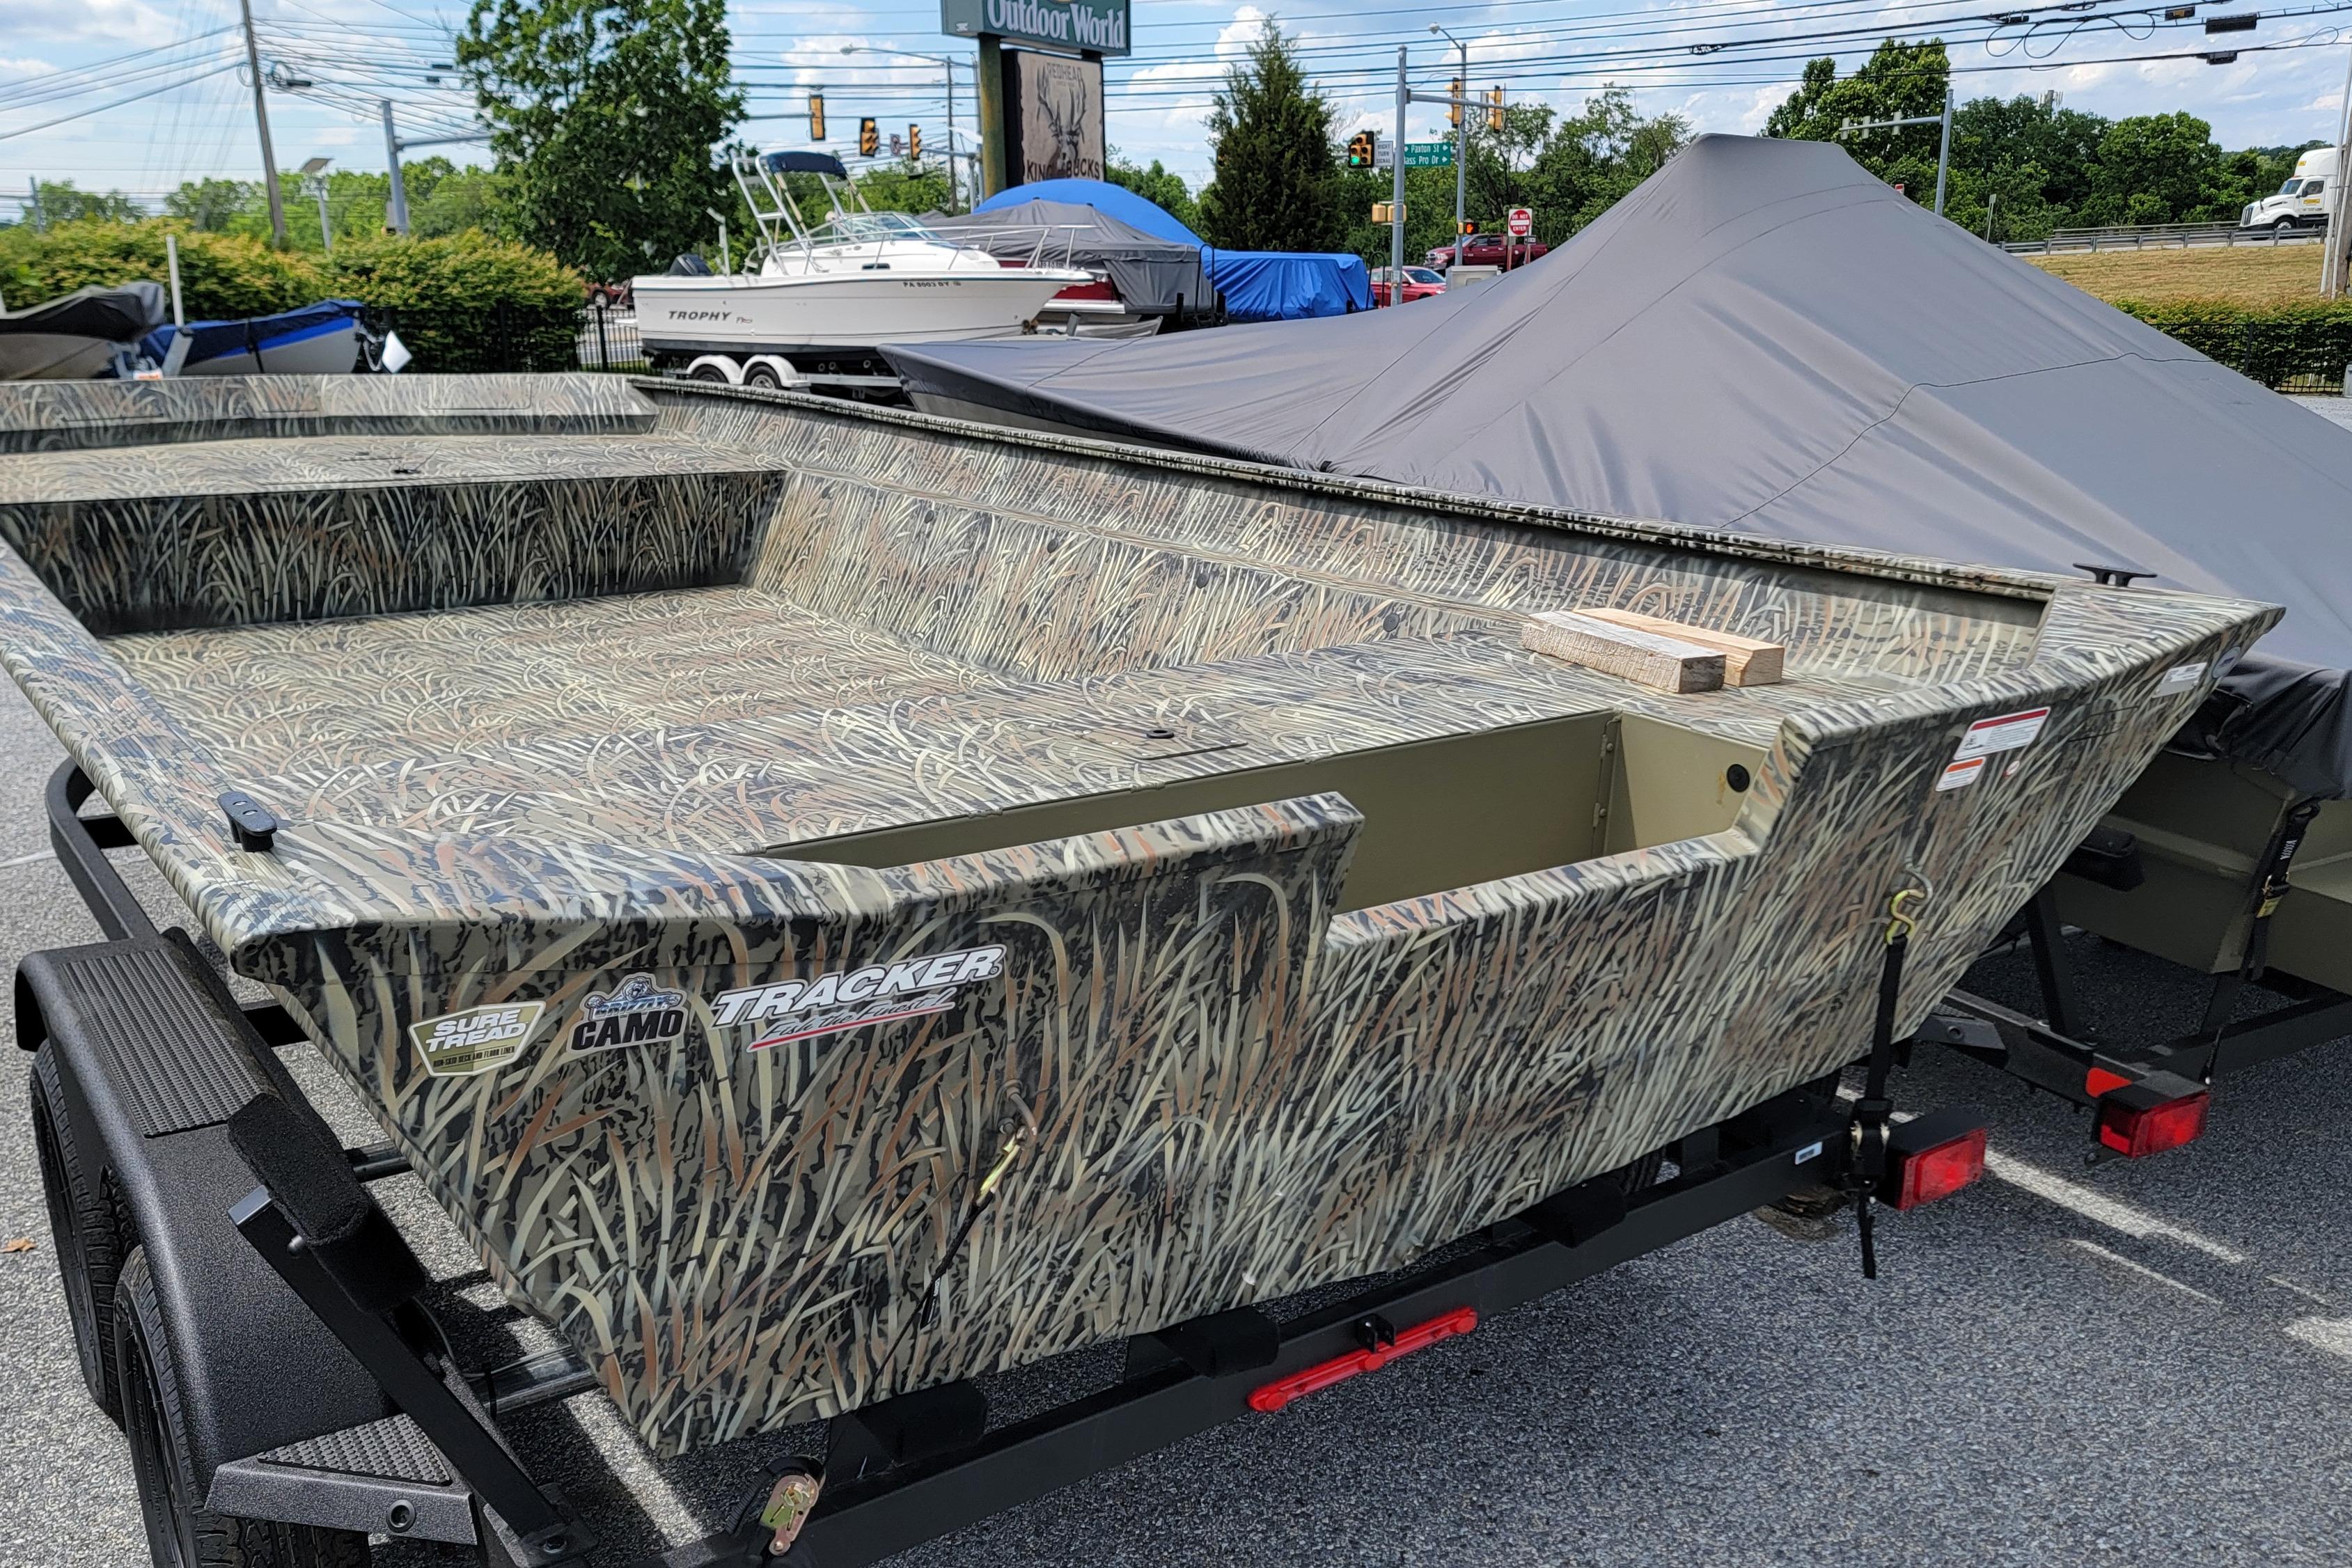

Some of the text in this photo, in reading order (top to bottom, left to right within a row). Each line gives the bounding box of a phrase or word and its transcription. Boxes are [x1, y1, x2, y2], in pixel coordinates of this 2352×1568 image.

[987, 0, 1126, 49] Outdoor World
[1411, 144, 1440, 153] Paxton St
[1418, 155, 1429, 165] Pro
[1432, 155, 1439, 164] Dr
[1066, 158, 1099, 180] BUCKS
[668, 311, 732, 320] TROPHY
[715, 947, 1005, 1025] TRACKER
[433, 1009, 521, 1037] SURE
[571, 1010, 684, 1050] CAMO
[765, 1019, 814, 1036] Fish
[819, 1011, 853, 1027] the
[425, 1022, 526, 1053] TREAD
[458, 1054, 471, 1063] DECK
[473, 1052, 483, 1060] AND
[484, 1049, 499, 1058] FLOOR
[501, 1046, 515, 1056] LINER
